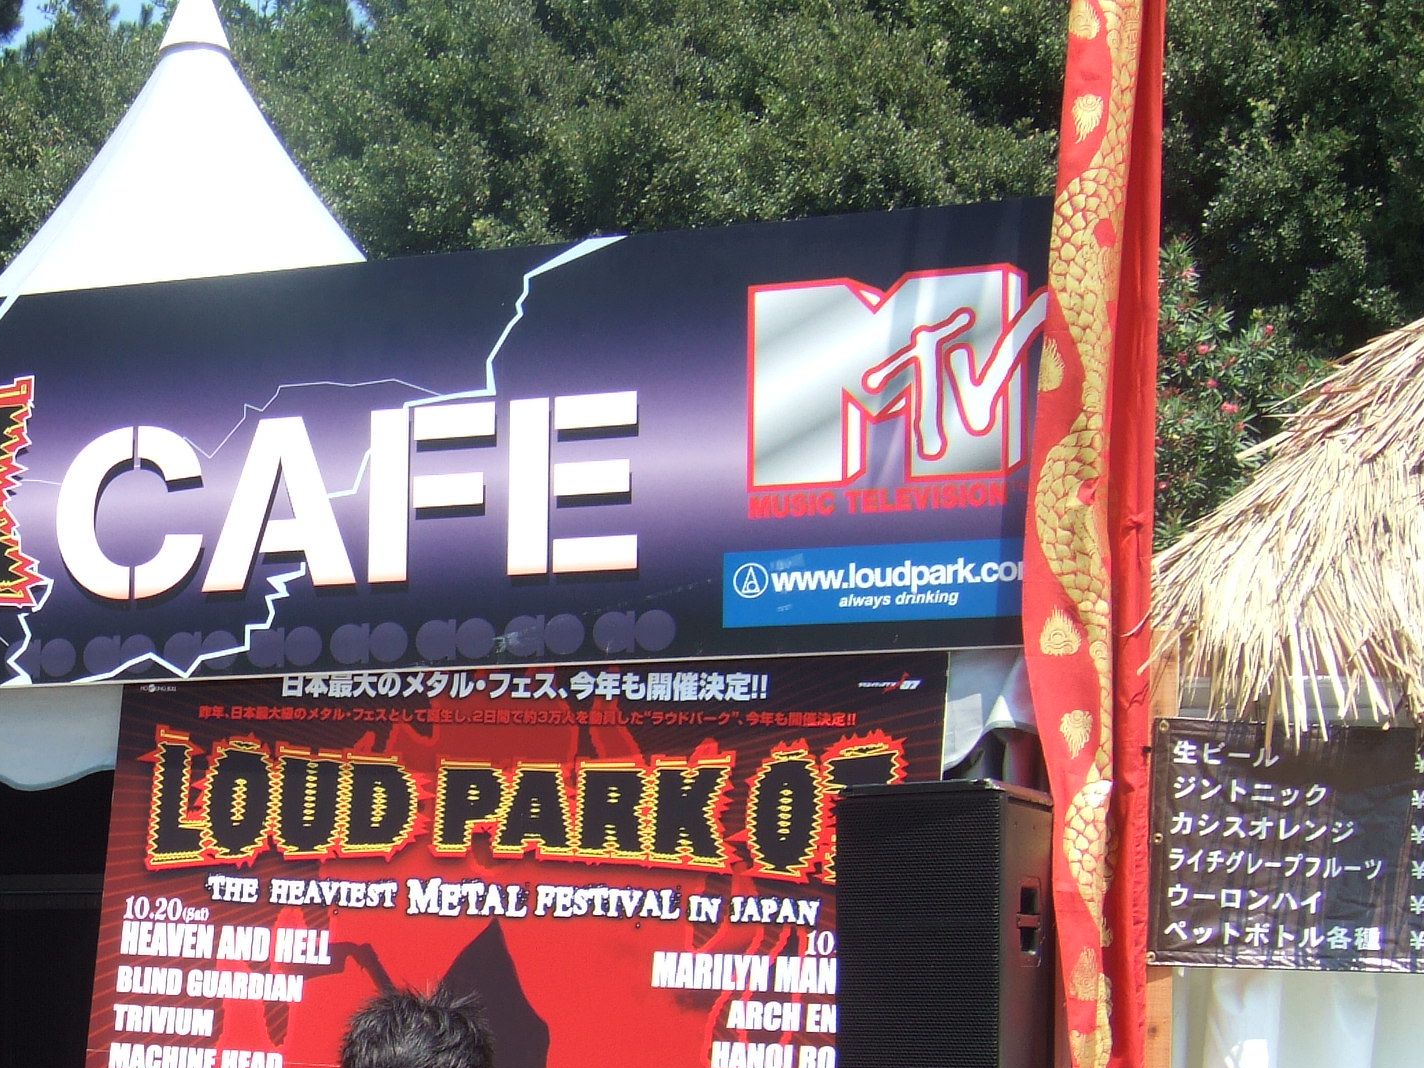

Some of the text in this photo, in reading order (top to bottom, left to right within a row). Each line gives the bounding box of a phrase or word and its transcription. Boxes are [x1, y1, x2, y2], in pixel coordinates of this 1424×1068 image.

[747, 263, 1049, 492] MTV
[56, 390, 639, 601] CAFE
[747, 483, 1007, 520] MUSIC TELEVISION
[838, 589, 960, 609] always drinking
[1173, 740, 1280, 767] 生ビール
[138, 722, 436, 871] LOUD
[431, 745, 740, 868] PARK
[1173, 776, 1327, 807] ジントニック
[1169, 811, 1355, 843] カシスオレンジ
[1168, 848, 1382, 880] ライチグレープフルーツ
[207, 873, 821, 926] THE HEAVIEST METAL FESTIVAL IN JAPAN
[1168, 883, 1322, 914] ウーロンハイ
[120, 921, 331, 965] HEAVEN AND HELL
[1164, 920, 1381, 951] ペットボトル各種
[116, 965, 304, 1003] BLIND GUARDIAN
[651, 951, 837, 994] MARILYN MAN
[113, 1003, 215, 1037] TRIVIUM
[726, 1000, 802, 1031] ARCH
